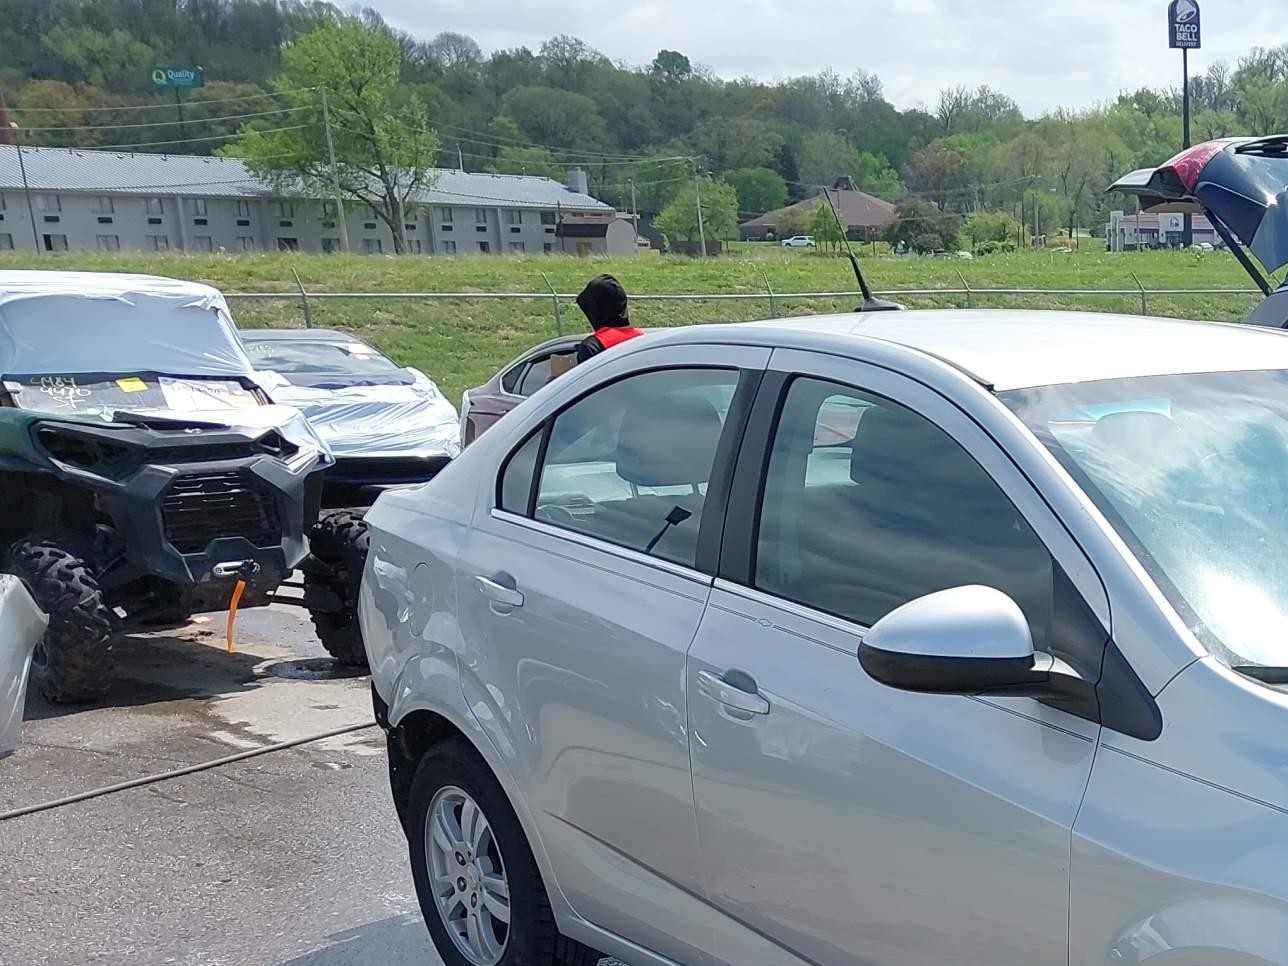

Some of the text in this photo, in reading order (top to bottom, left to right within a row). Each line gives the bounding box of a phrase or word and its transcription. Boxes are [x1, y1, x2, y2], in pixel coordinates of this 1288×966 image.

[1174, 23, 1198, 33] TACO
[1176, 32, 1198, 41] BELL
[167, 69, 195, 81] Quality
